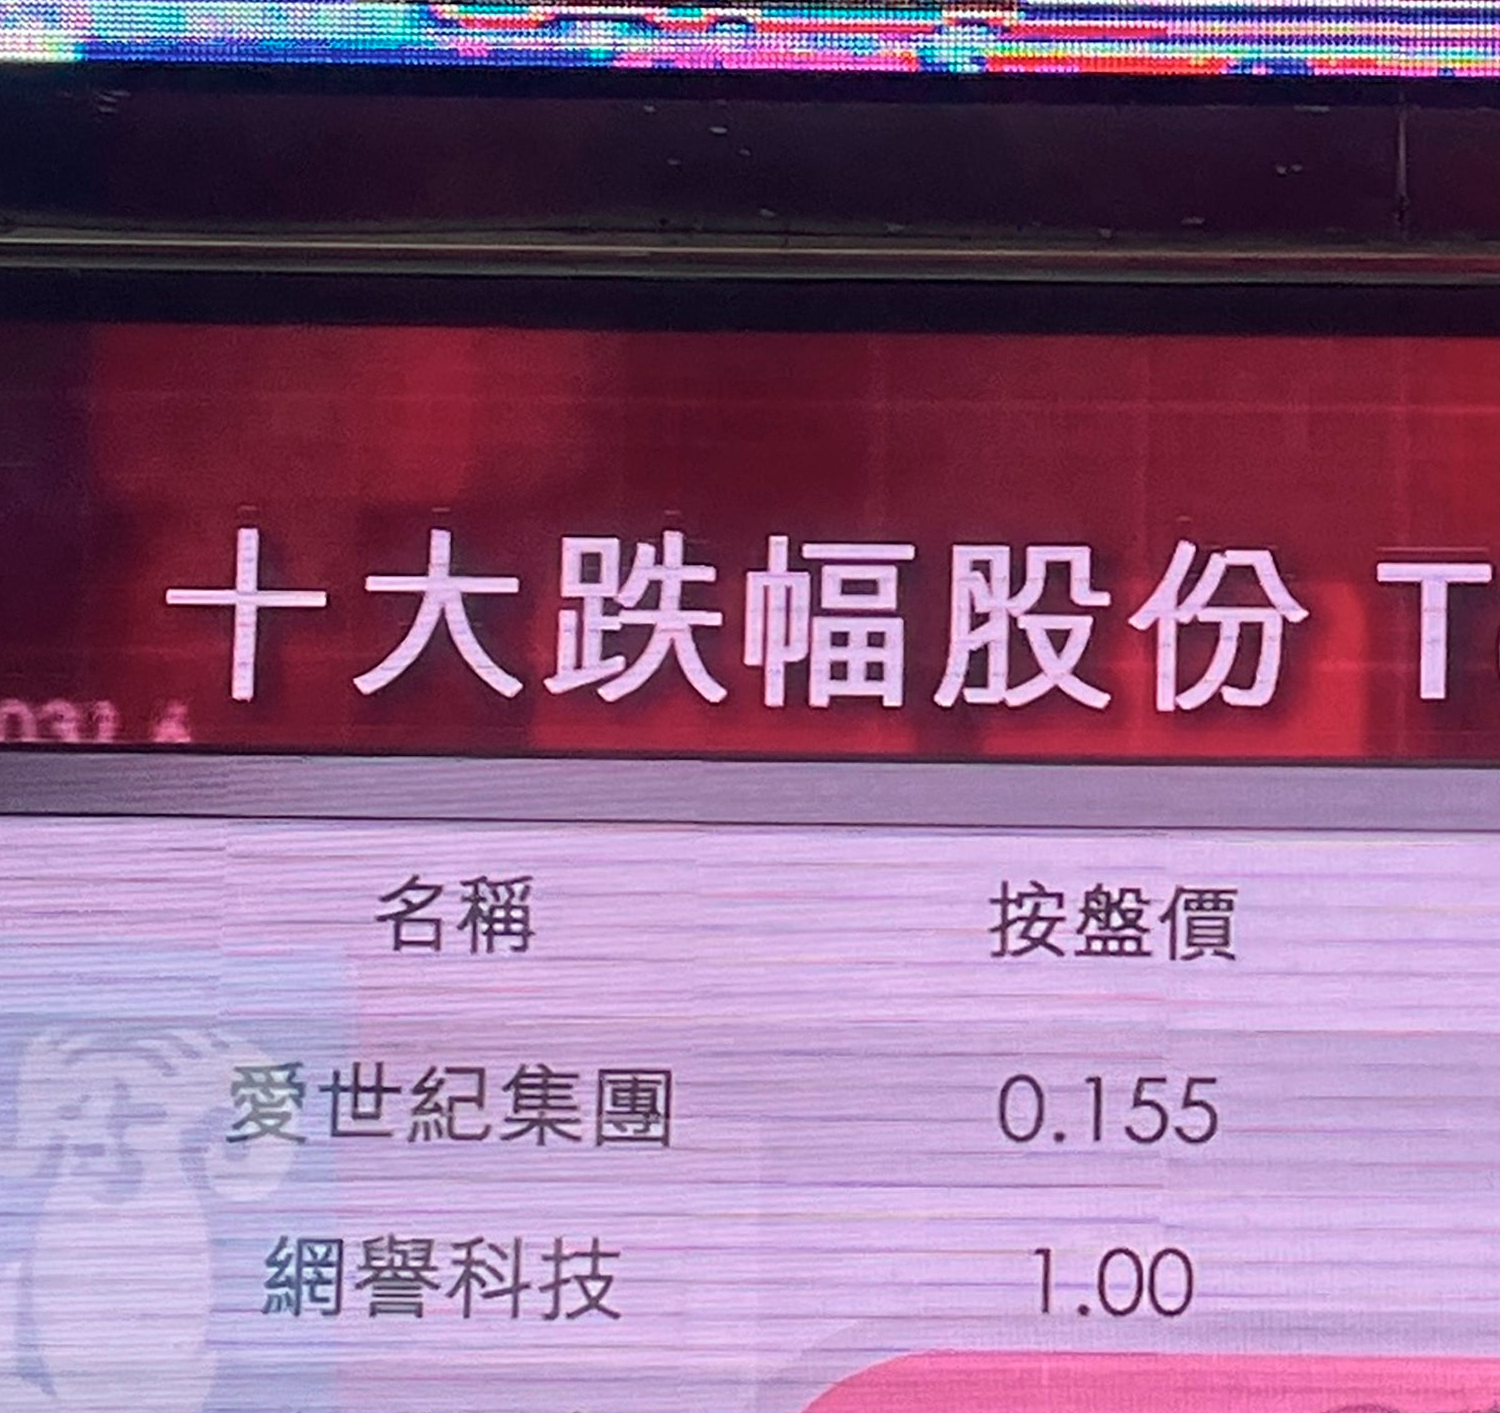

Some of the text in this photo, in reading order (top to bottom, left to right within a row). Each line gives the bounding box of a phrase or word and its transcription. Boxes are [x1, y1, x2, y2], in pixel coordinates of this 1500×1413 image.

[165, 527, 1309, 712] 十大跌幅股份
[375, 875, 535, 954] 名稱
[989, 880, 1238, 961] 按盤價
[226, 1061, 672, 1148] 愛世紀集團
[998, 1074, 1218, 1145] 0.155
[261, 1234, 621, 1321] 網譽科技
[1034, 1247, 1194, 1318] 1.00
